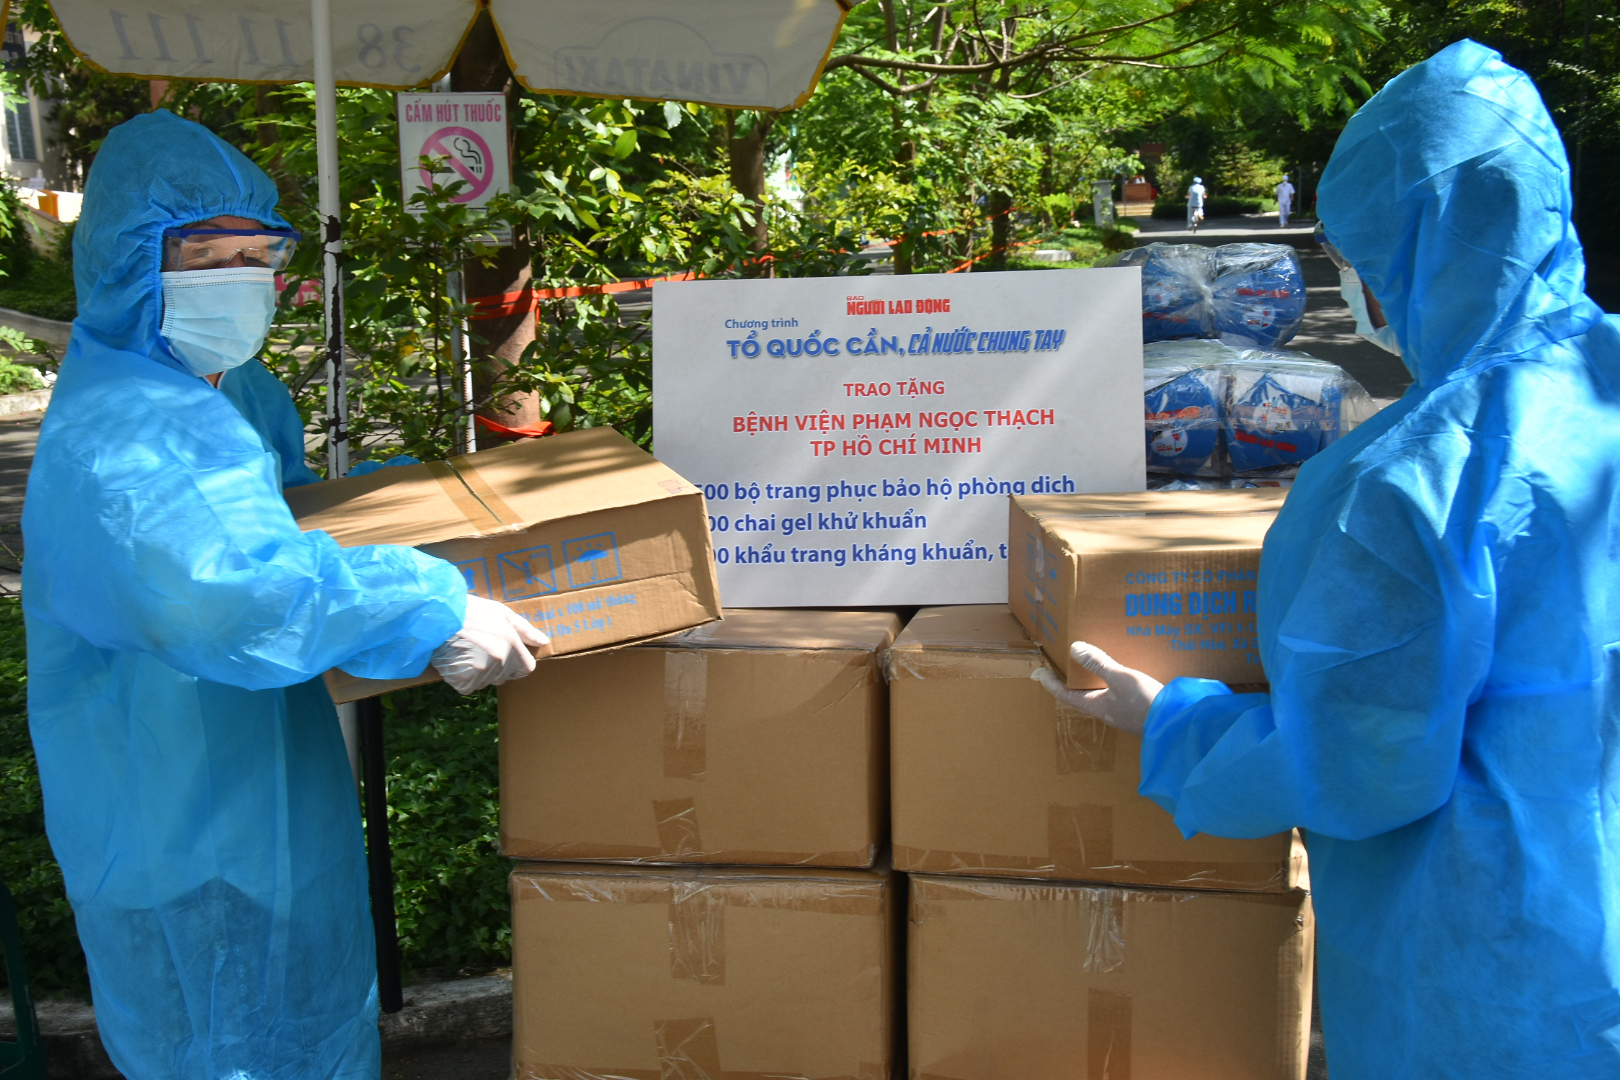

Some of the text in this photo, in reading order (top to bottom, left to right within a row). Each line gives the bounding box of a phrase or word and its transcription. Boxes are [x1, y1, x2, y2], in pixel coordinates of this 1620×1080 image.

[405, 98, 502, 123] CẤM HÚT THUỐC
[847, 298, 950, 315] NGƯỜI LAO ĐỘNG
[725, 317, 798, 330] Chương trình
[726, 326, 1065, 358] TỔ QUỐC CẦN, CẢ NƯỚC CHUNG TAY
[843, 377, 945, 399] TRAO TẶNG
[733, 408, 1055, 436] BỆNH VIỆN PHẠM NGỌC THẠCH
[810, 433, 982, 456] TP HỒ CHÍ MINH
[695, 483, 729, 500] 00
[735, 482, 760, 505] bộ
[766, 483, 821, 503] trang
[827, 480, 877, 502] phục
[883, 478, 921, 497] bảo
[927, 478, 953, 500] hộ
[959, 477, 1026, 500] phòng
[735, 514, 776, 531] chai
[782, 512, 812, 536] gel
[818, 511, 858, 530] khử
[863, 508, 927, 530] khuẩn
[735, 543, 786, 564] khẩu
[791, 547, 846, 567] trang
[852, 543, 917, 566] kháng
[923, 540, 994, 562] khuẩn,
[1126, 570, 1168, 585] CÔNG
[1171, 571, 1190, 583] TY
[533, 608, 556, 622] chai
[566, 601, 585, 616] 100
[1126, 593, 1182, 616] DUNG
[1189, 591, 1236, 619] DỊCH
[573, 620, 582, 633] 5
[1126, 624, 1151, 637] Nhà
[1155, 623, 1180, 639] Máy
